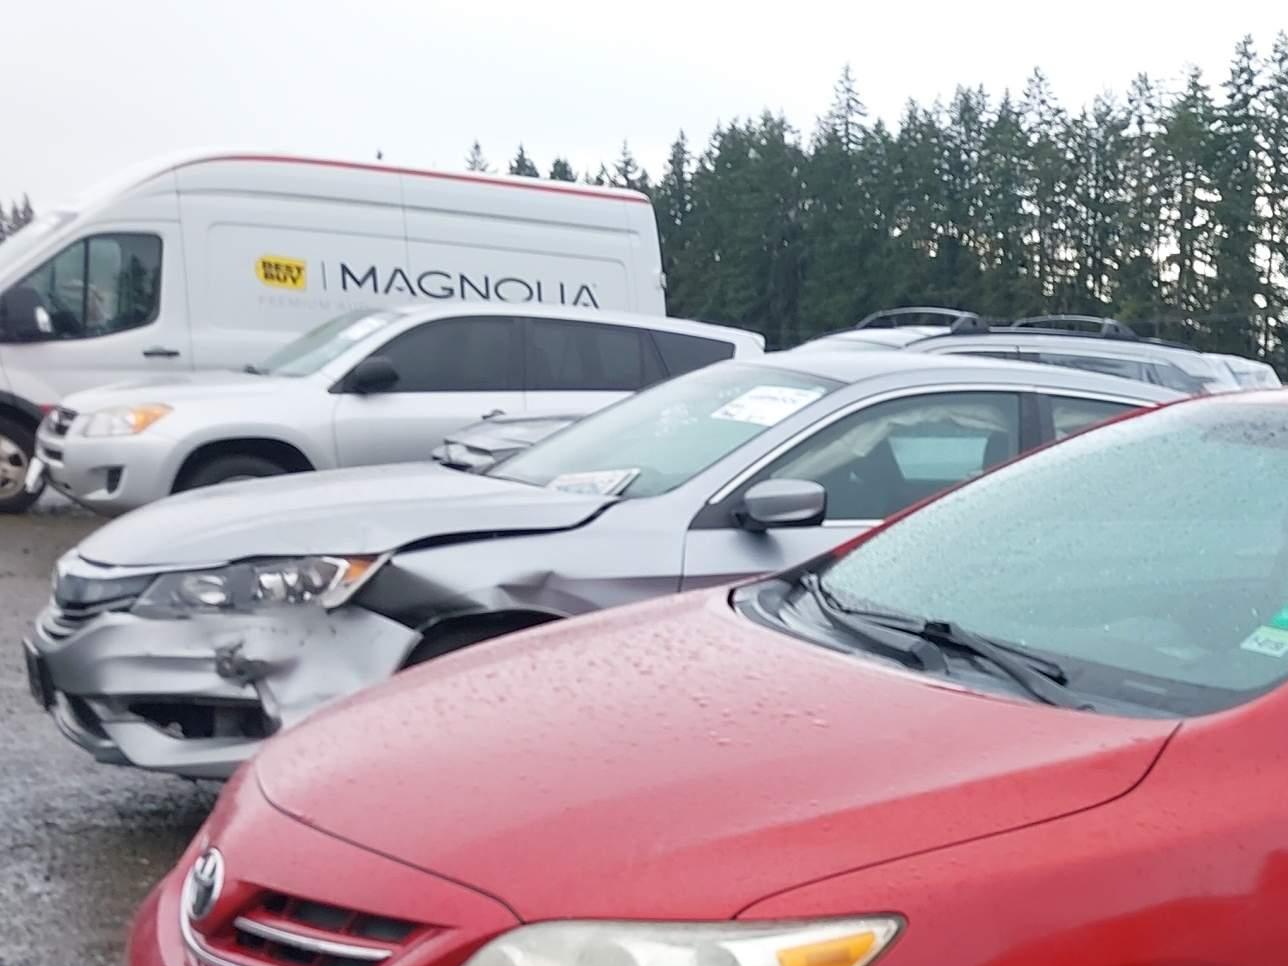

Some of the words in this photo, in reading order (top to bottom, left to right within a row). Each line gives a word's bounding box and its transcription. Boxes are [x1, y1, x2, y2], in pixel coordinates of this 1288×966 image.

[261, 259, 304, 276] BEST
[263, 270, 299, 285] BUY
[340, 261, 599, 309] MAGNOLIA
